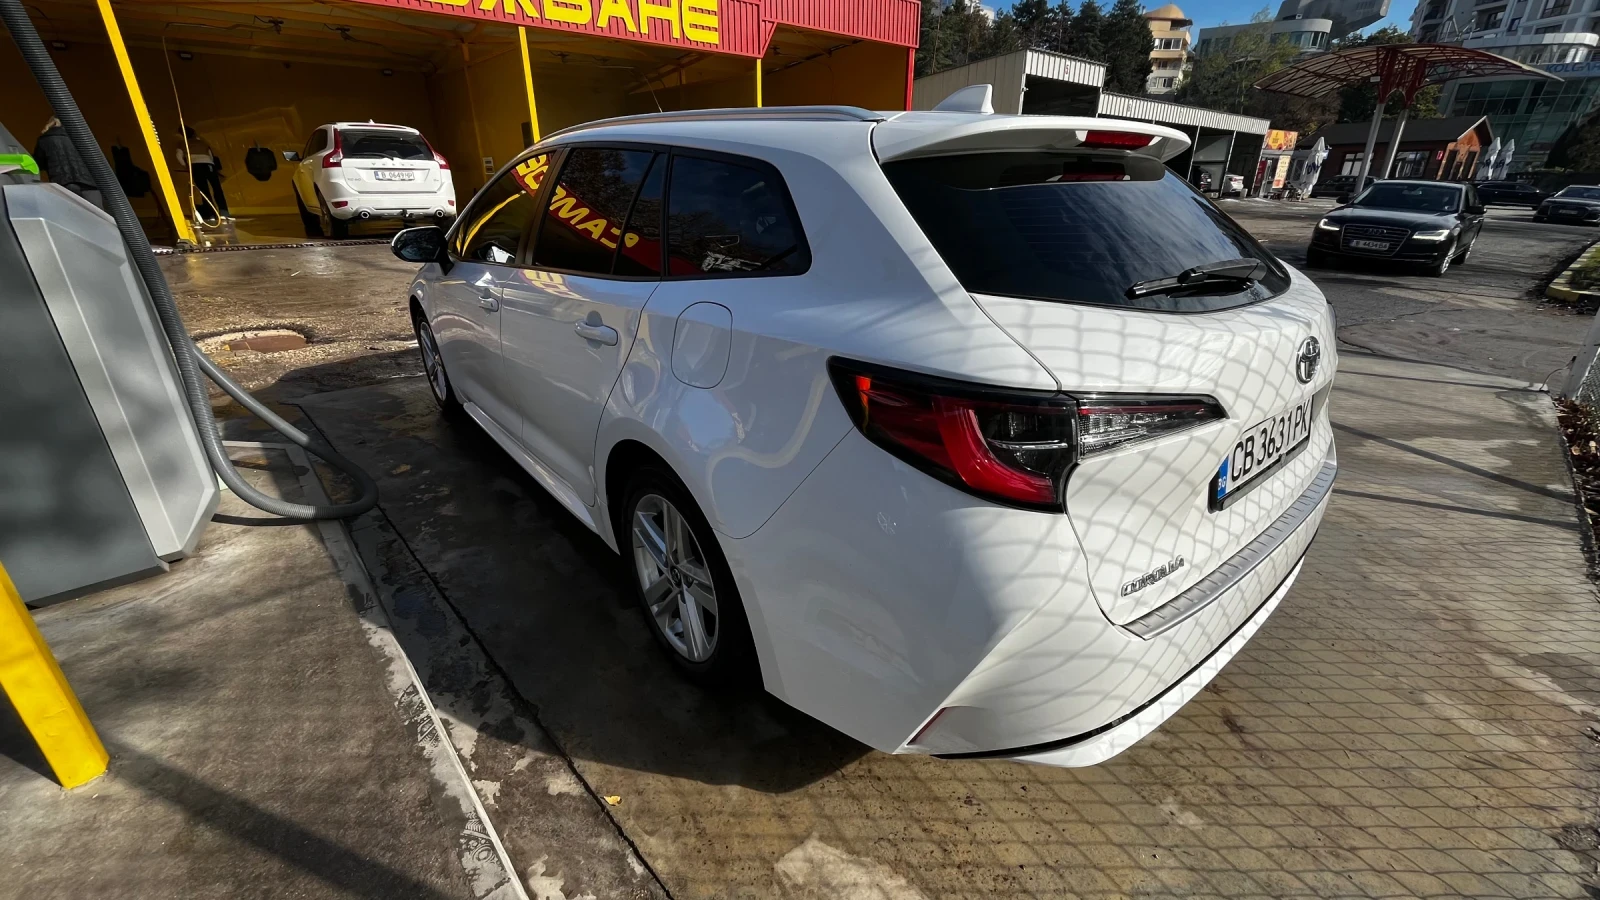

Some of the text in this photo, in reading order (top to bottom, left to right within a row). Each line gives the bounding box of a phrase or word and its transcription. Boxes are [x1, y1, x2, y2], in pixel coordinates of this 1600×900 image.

[1231, 400, 1310, 482] CB 3631 PK
